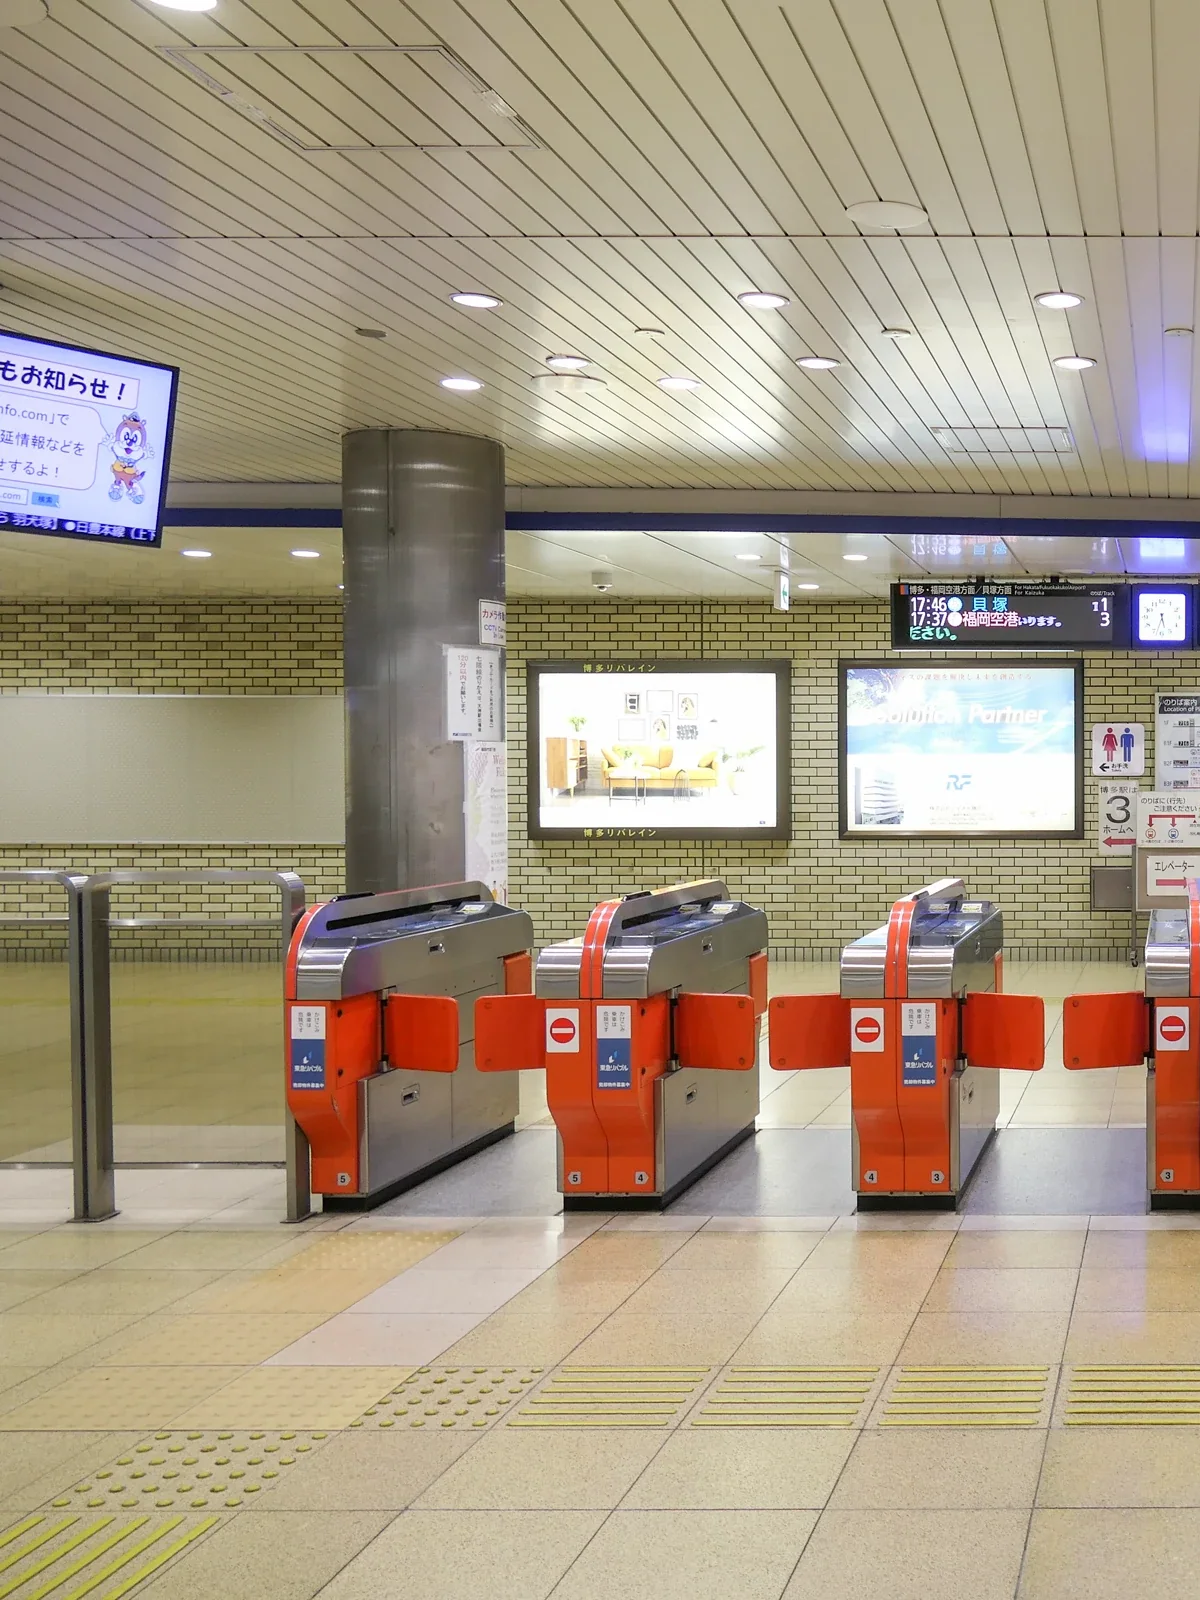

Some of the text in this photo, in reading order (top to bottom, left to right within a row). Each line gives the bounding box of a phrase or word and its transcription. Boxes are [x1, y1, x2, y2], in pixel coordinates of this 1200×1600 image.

[910, 597, 947, 612] 17:46
[972, 597, 1008, 612] 貝塚
[1100, 597, 1108, 611] 1
[910, 612, 947, 626] 17:37
[962, 611, 1018, 627] 福岡空港
[1100, 612, 1110, 626] 3
[583, 663, 657, 673] 博多リバレイン
[968, 703, 1049, 724] Partner
[1100, 786, 1138, 794] 博多駅は
[1140, 797, 1186, 805] のりばに（行先）
[1106, 795, 1131, 824] 3
[583, 828, 657, 837] 博多リバレイン
[1103, 825, 1134, 834] ホームへ
[1154, 861, 1195, 872] エレベーター
[340, 1175, 346, 1183] 5
[572, 1174, 579, 1182] 5
[637, 1173, 644, 1182] 4
[868, 1172, 875, 1181] 4
[934, 1173, 940, 1181] 3
[1165, 1171, 1171, 1179] 3
